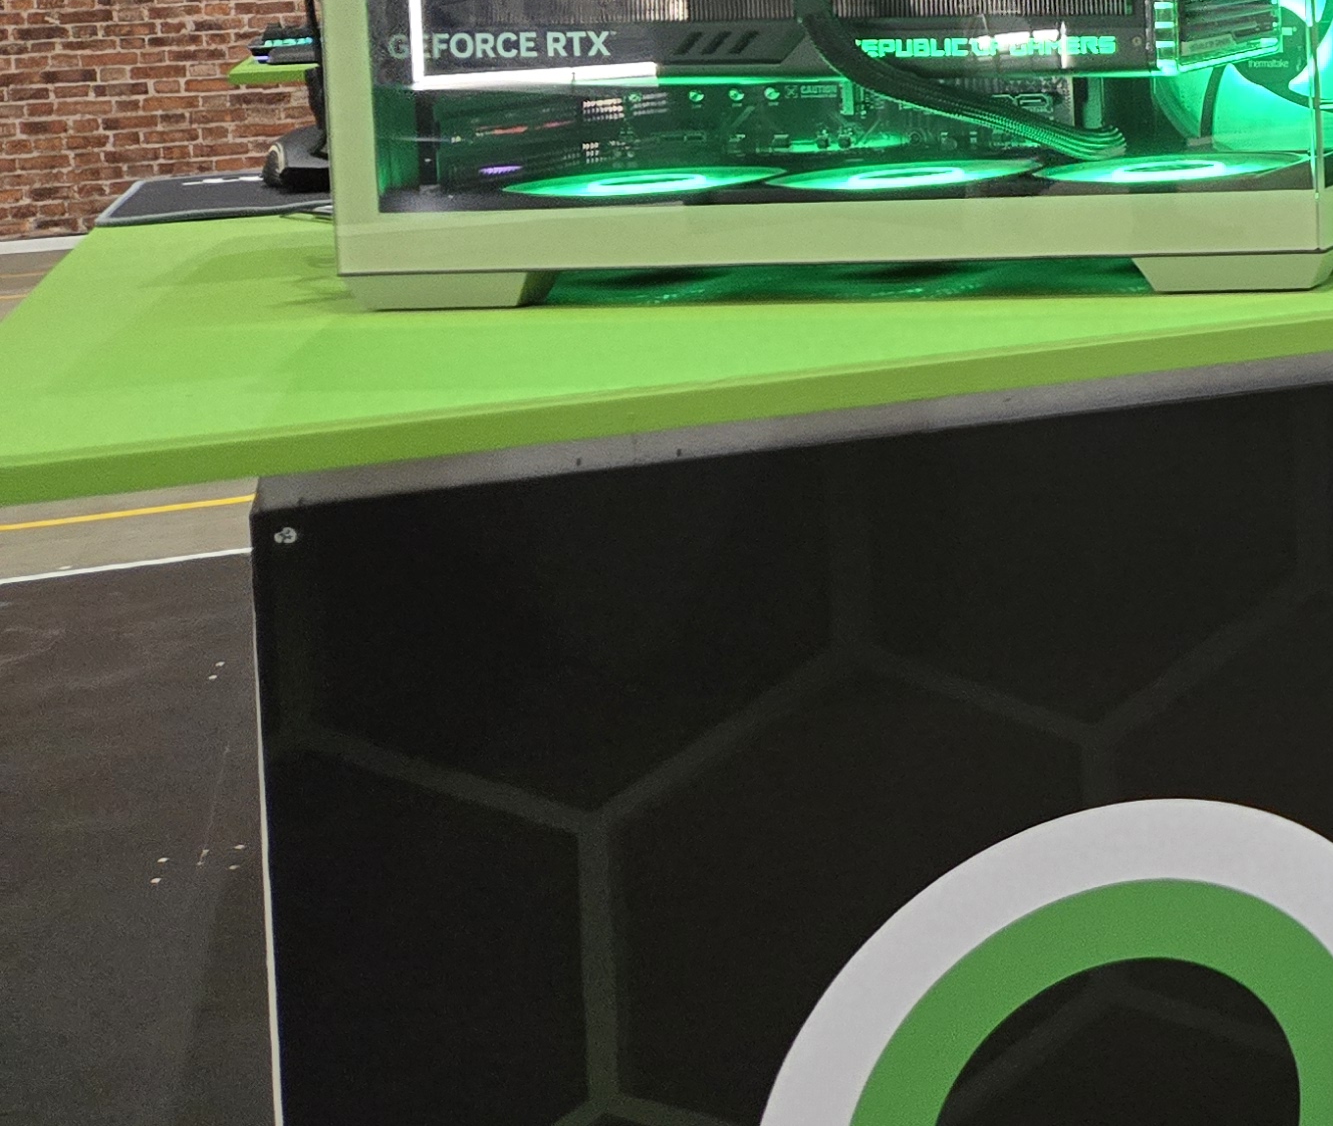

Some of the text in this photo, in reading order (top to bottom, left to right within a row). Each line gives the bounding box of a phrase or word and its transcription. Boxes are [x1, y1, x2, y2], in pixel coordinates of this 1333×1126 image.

[547, 30, 611, 57] RTX
[855, 37, 970, 58] EPUBLIC
[1248, 58, 1290, 69] thermaltake
